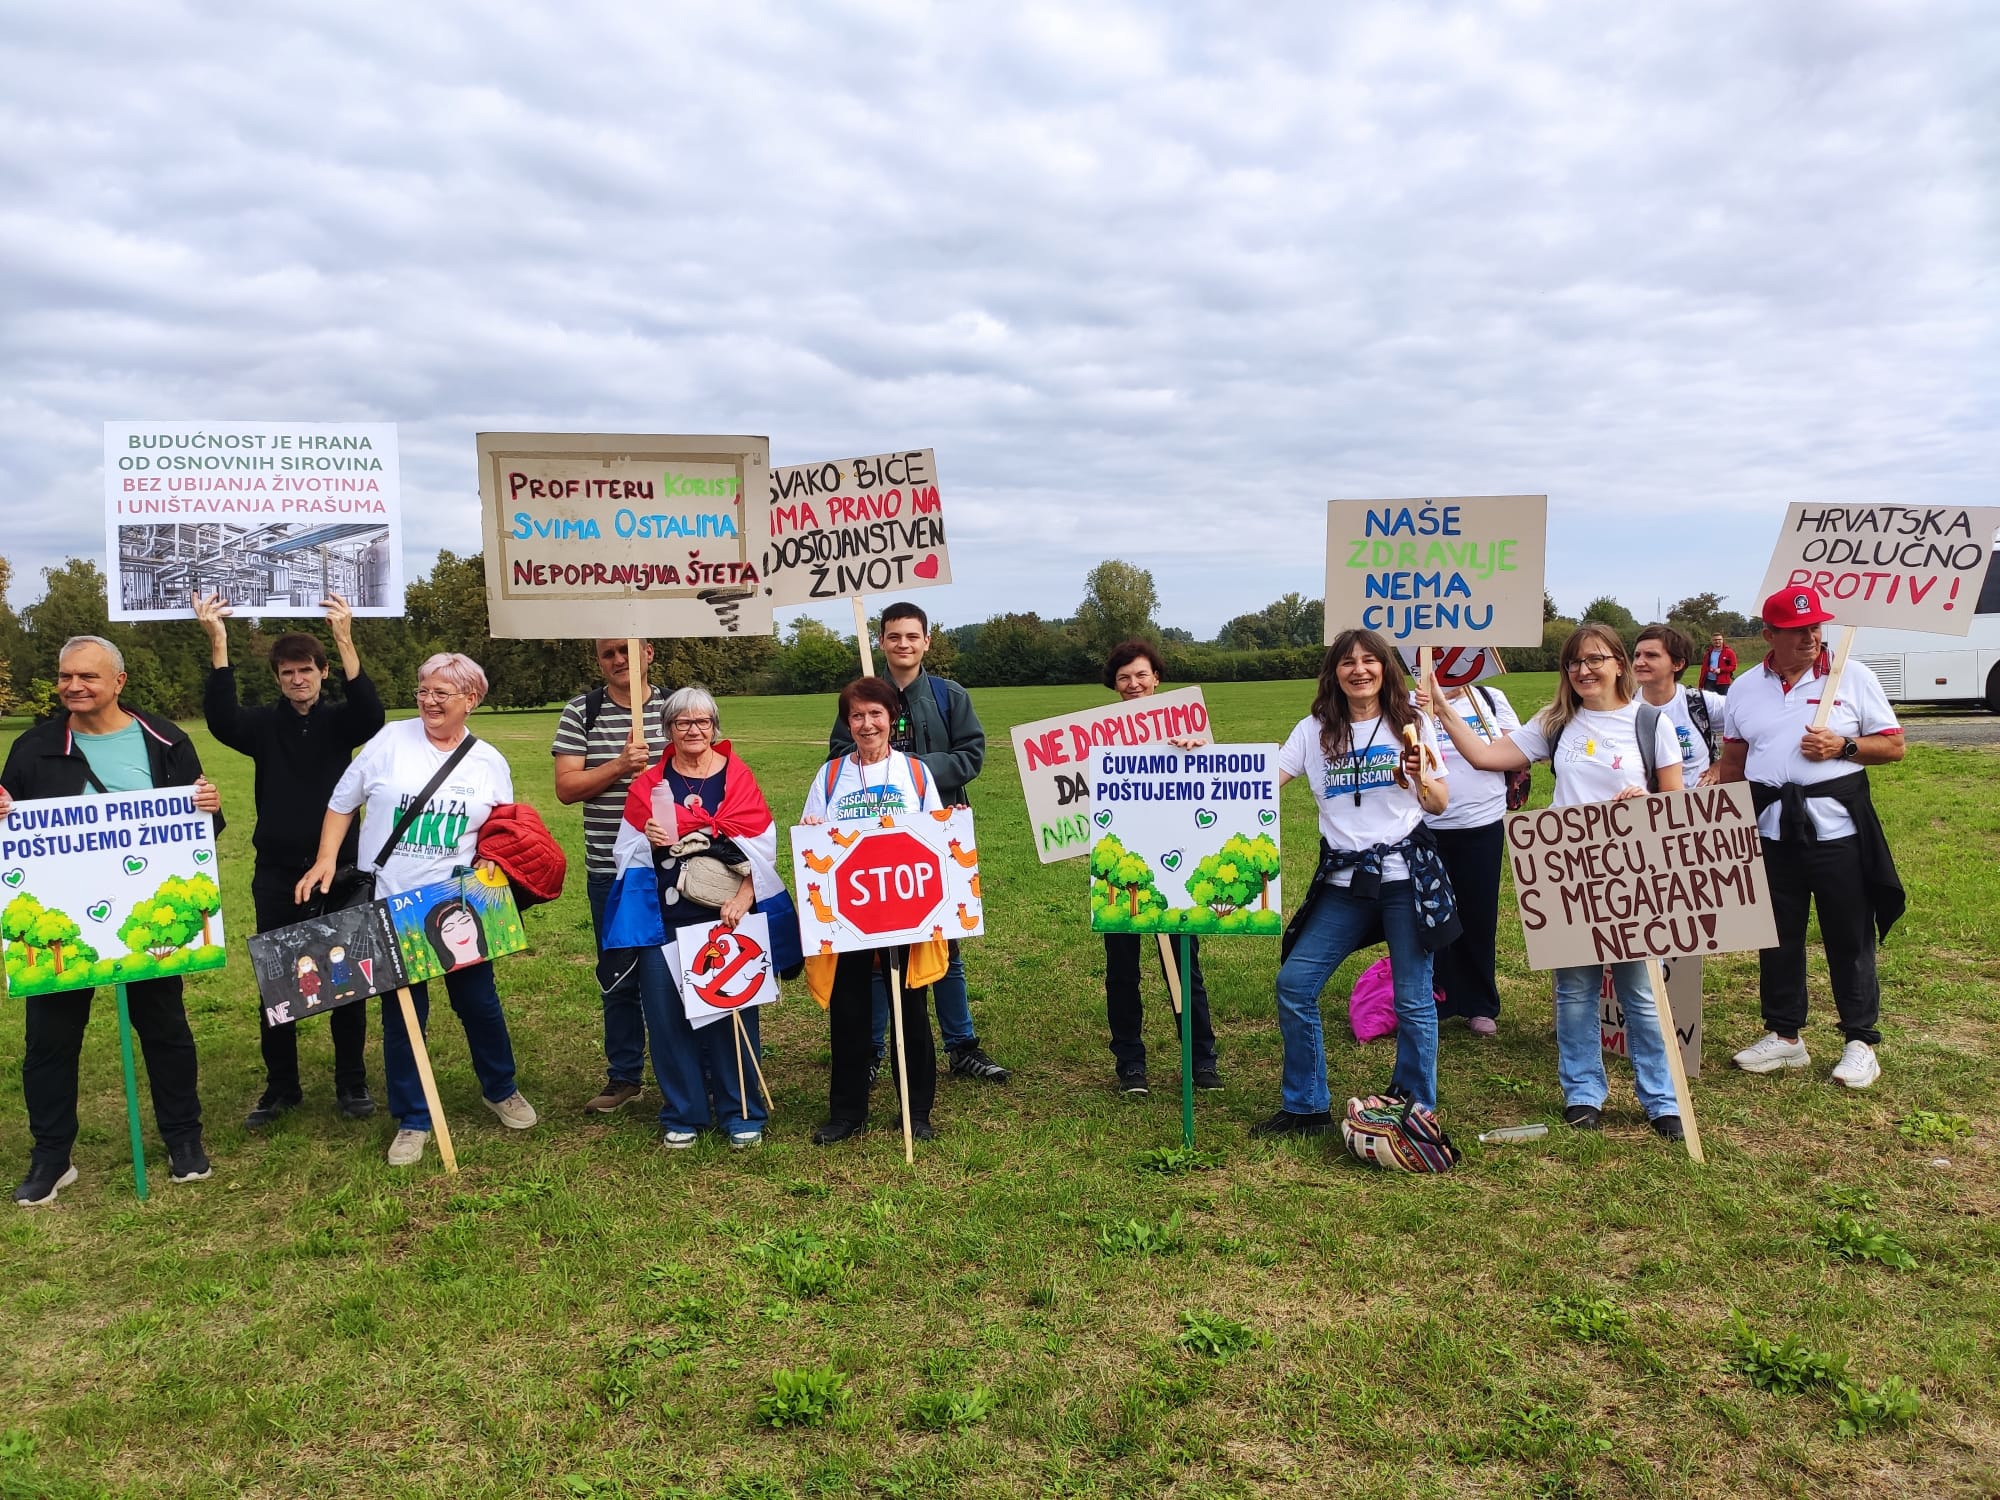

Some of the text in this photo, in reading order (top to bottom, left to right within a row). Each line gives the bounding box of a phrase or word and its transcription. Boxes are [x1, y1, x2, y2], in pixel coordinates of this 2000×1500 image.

[129, 431, 372, 450] BUDUĆNOST JE HRANA
[118, 456, 383, 471] OD OSNOVNIH SIROVINA
[853, 452, 928, 489] BIĆE
[123, 474, 379, 492] BEZ UBIJANJA ŽIVOTINJA
[509, 471, 741, 504] PROFITERU KORIST,
[117, 496, 386, 514] I UNIŠTAVANJA PRAŠUMA
[770, 486, 941, 536] IMA PRAVO NA
[1365, 499, 1461, 537] NAŠE
[1796, 507, 1972, 538] HRVATSKA
[512, 508, 738, 540] SVIMA OSTALIMA
[1346, 540, 1518, 580] ZDRAVLJE
[1802, 536, 1982, 570] ODLUČNO
[809, 555, 913, 597] ŽIVOT
[1365, 571, 1472, 600] NEMA
[1362, 603, 1493, 639] CIJENU
[1024, 703, 1207, 771] NE DOPUSTIMO
[1102, 752, 1265, 774] ČUVAMO PRIRODU
[1054, 772, 1089, 805] DA
[1097, 777, 1273, 801] POŠTUJEMO ŽIVOTE
[7, 796, 197, 832] ČUVAMO PRIRODU
[1646, 789, 1742, 833] PLIVA
[3, 821, 206, 860] POŠTUJEMO ŽIVOTE
[1515, 825, 1763, 886] U SMEĆU, FEKALIJE
[850, 862, 933, 907] STOP
[1520, 865, 1756, 930] S MEGAFARMI
[1592, 913, 1718, 962] NEĆU!
[266, 1001, 294, 1027] NE
